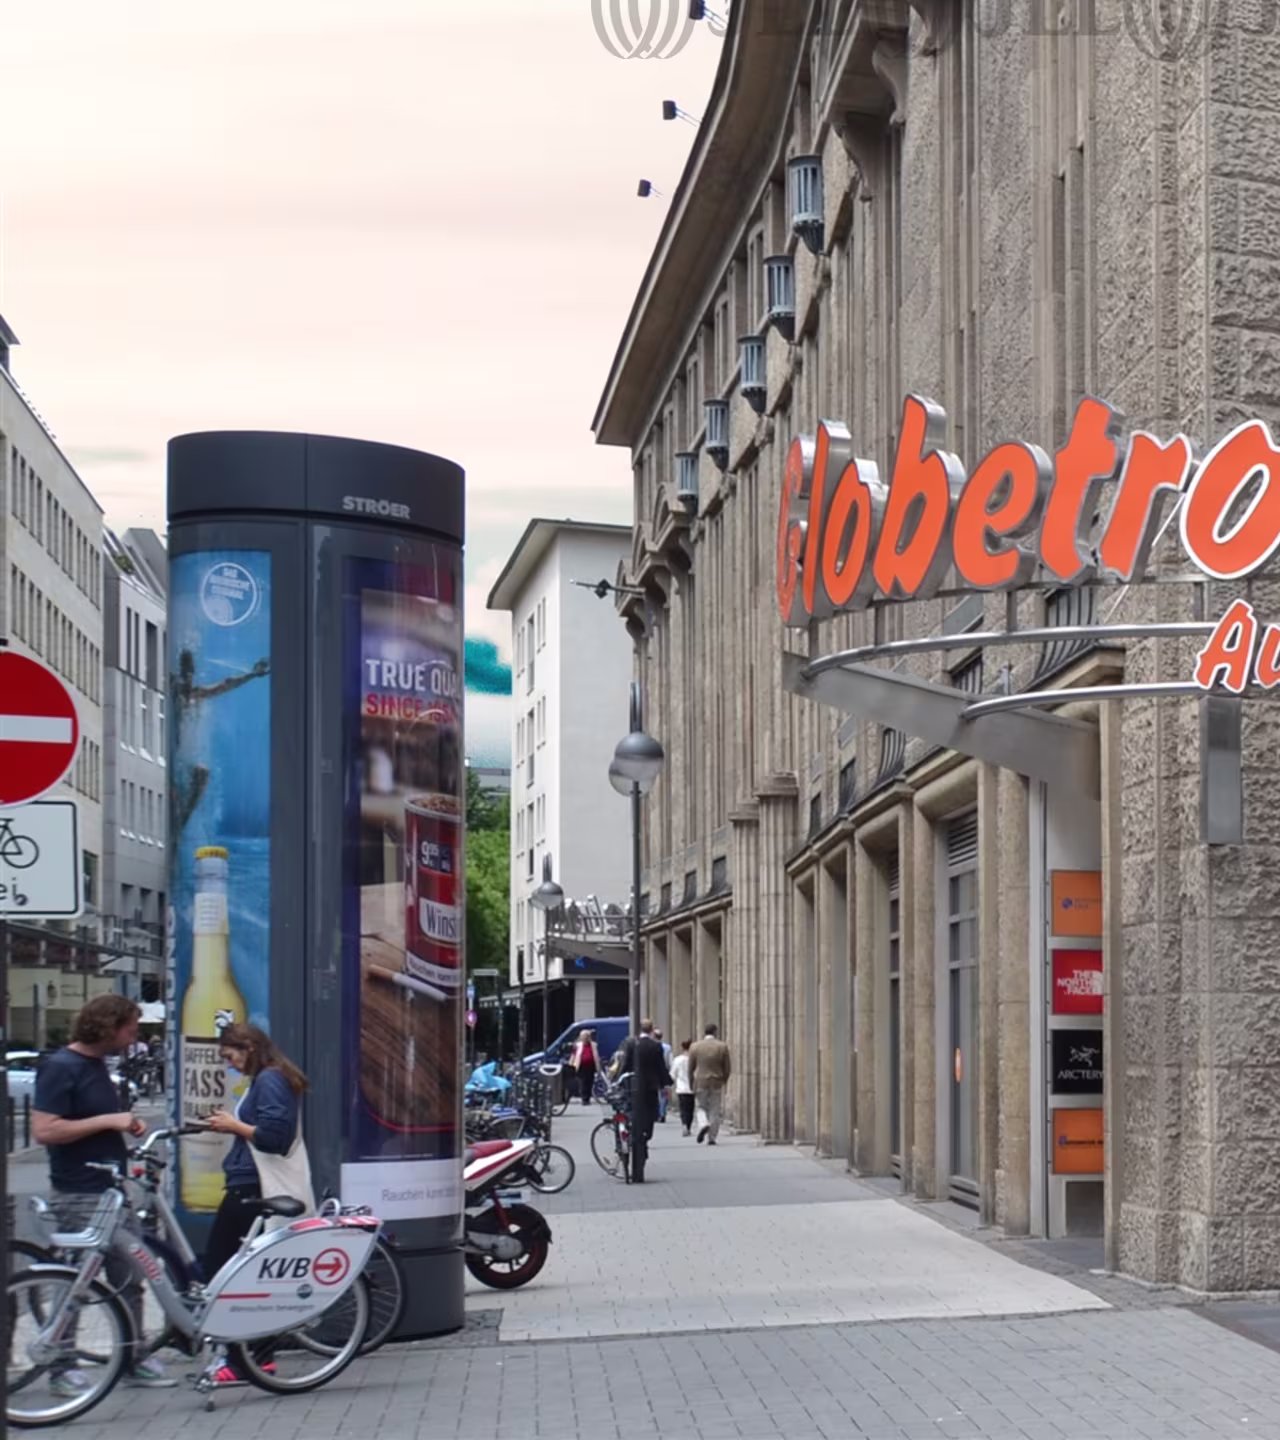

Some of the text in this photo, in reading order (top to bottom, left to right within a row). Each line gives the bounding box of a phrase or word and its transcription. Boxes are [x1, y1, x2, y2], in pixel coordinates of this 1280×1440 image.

[342, 496, 410, 519] STRÖER
[365, 659, 426, 691] TRUE
[366, 693, 423, 720] SINCE
[184, 1069, 225, 1097] FASS
[1057, 1069, 1103, 1079] ARC'TERY
[258, 1257, 311, 1279] KVB
